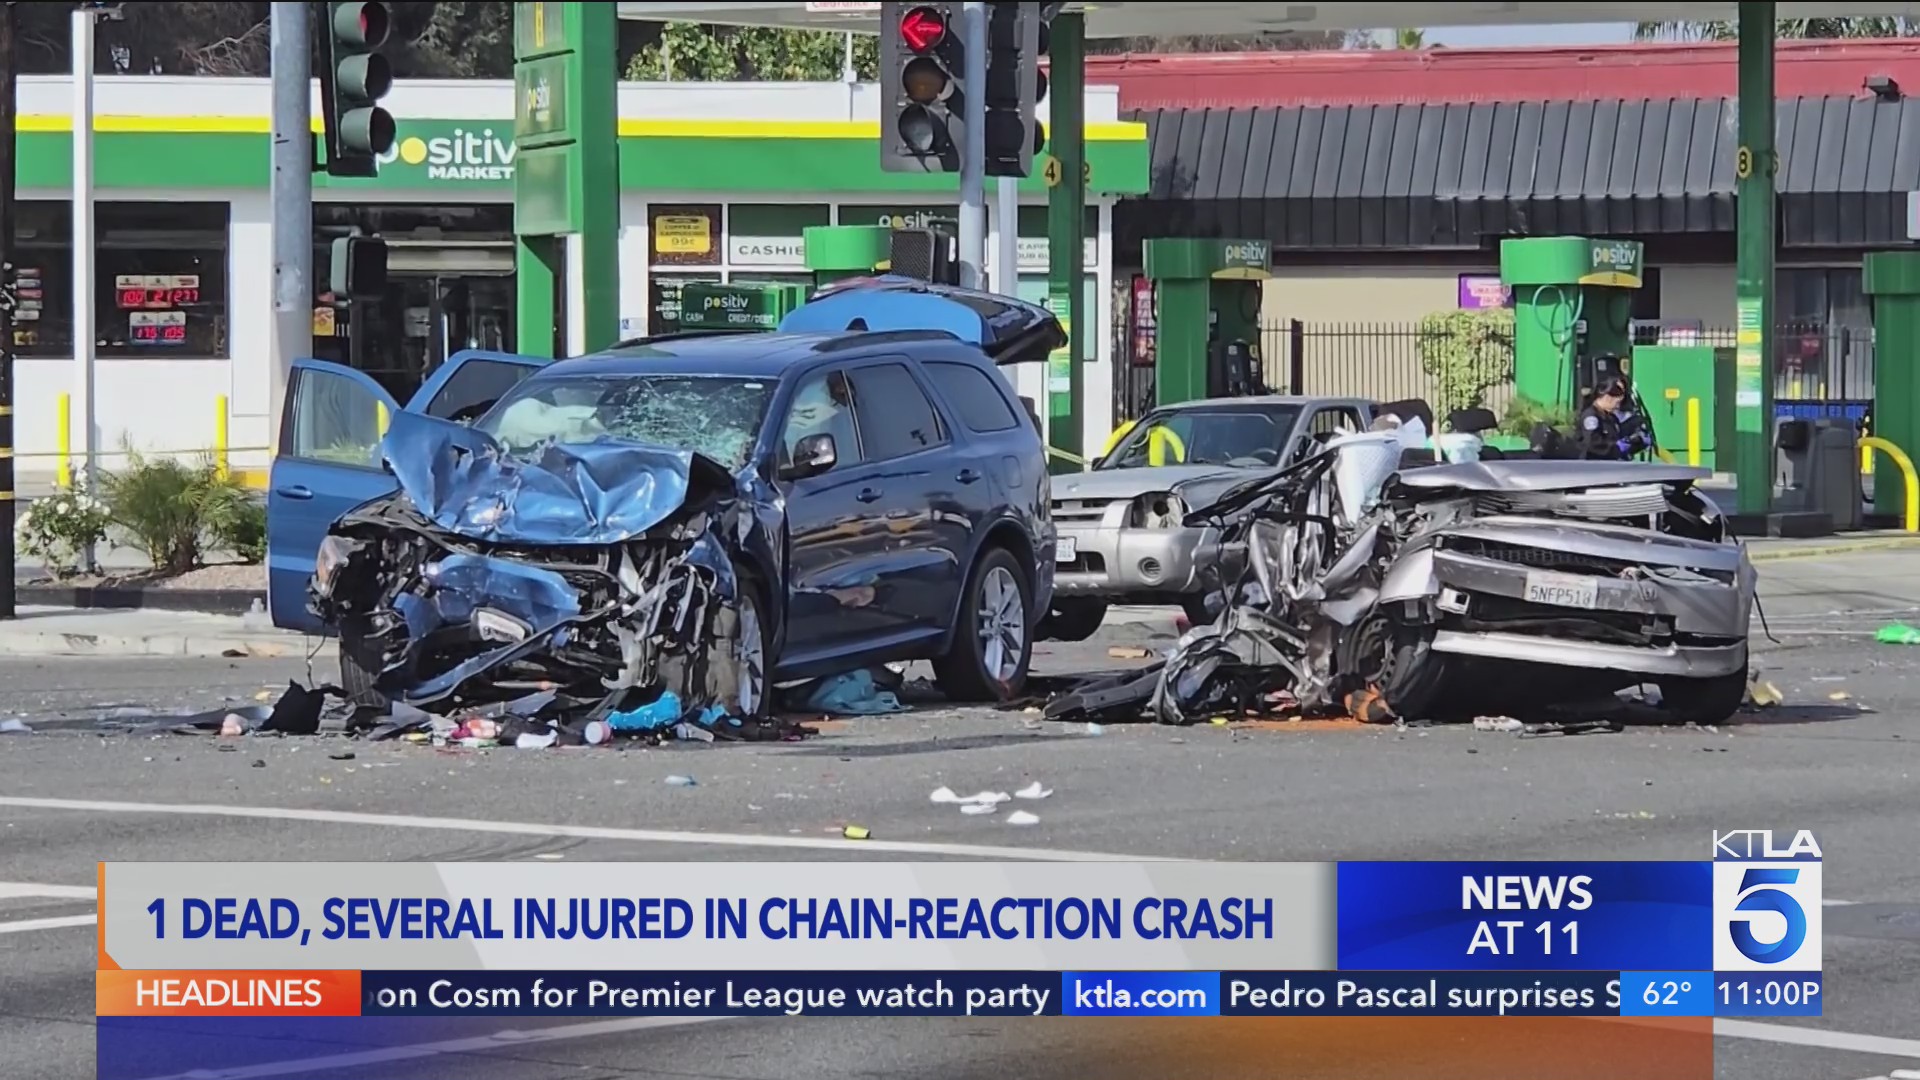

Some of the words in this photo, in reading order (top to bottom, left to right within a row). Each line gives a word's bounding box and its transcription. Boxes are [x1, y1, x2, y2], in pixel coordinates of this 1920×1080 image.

[1045, 161, 1056, 181] 4
[1739, 151, 1748, 173] 8
[428, 166, 515, 179] MARKET
[738, 245, 805, 256] CASHIE
[1225, 241, 1267, 264] positiv
[1592, 244, 1636, 267] positiv
[704, 294, 749, 311] positiv
[685, 313, 704, 322] CASH
